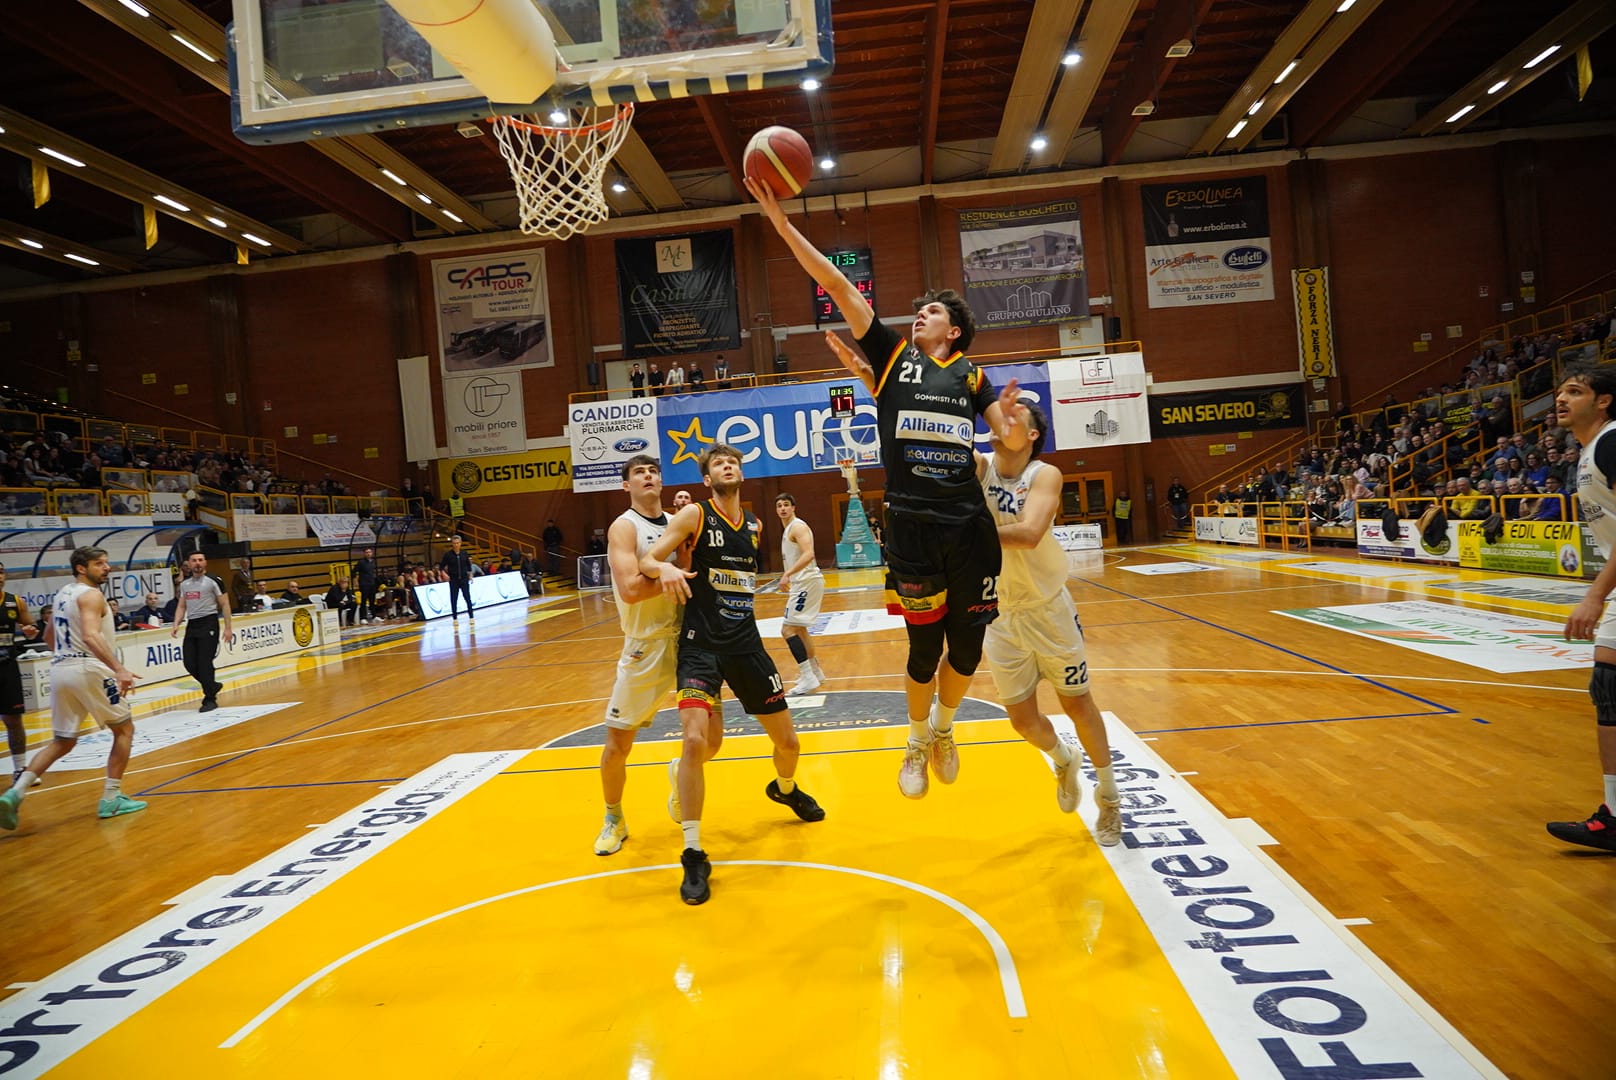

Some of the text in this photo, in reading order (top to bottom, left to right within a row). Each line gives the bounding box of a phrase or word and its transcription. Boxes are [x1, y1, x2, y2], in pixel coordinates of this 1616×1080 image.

[1165, 187, 1243, 207] ERBOLINEA
[960, 202, 1077, 222] RESIDENCE BOSCHETTO
[491, 278, 524, 291] TOUR
[1204, 291, 1236, 300] SEVERO
[823, 303, 832, 314] 3
[987, 305, 1071, 321] GRUPPO GIULIANO
[1307, 286, 1321, 360] FORZA NERI
[898, 361, 922, 384] 21
[837, 396, 853, 411] 17
[914, 393, 950, 403] GOMMISTI
[572, 403, 654, 423] CANDIDO
[1161, 401, 1255, 425] SAN SEVERO
[454, 420, 518, 434] mobili priore
[900, 417, 954, 435] Allianz
[620, 440, 643, 451] Ford
[914, 449, 968, 463] euronics
[483, 461, 568, 482] CESTISTICA
[160, 503, 182, 514] LUCE
[996, 486, 1017, 516] 22
[707, 529, 725, 547] 18
[1510, 523, 1536, 540] EDIL
[1544, 524, 1574, 541] CEM
[712, 573, 748, 587] Allianz
[241, 622, 284, 642] PAZIENZA
[241, 636, 285, 652] assicurazioni
[146, 642, 184, 668] Allia
[1065, 660, 1088, 686] 22
[769, 673, 783, 694] 18
[664, 727, 744, 738] MMI
[222, 789, 444, 899] Energia
[1151, 853, 1425, 1080] Fortore
[0, 904, 264, 1075] ortore
